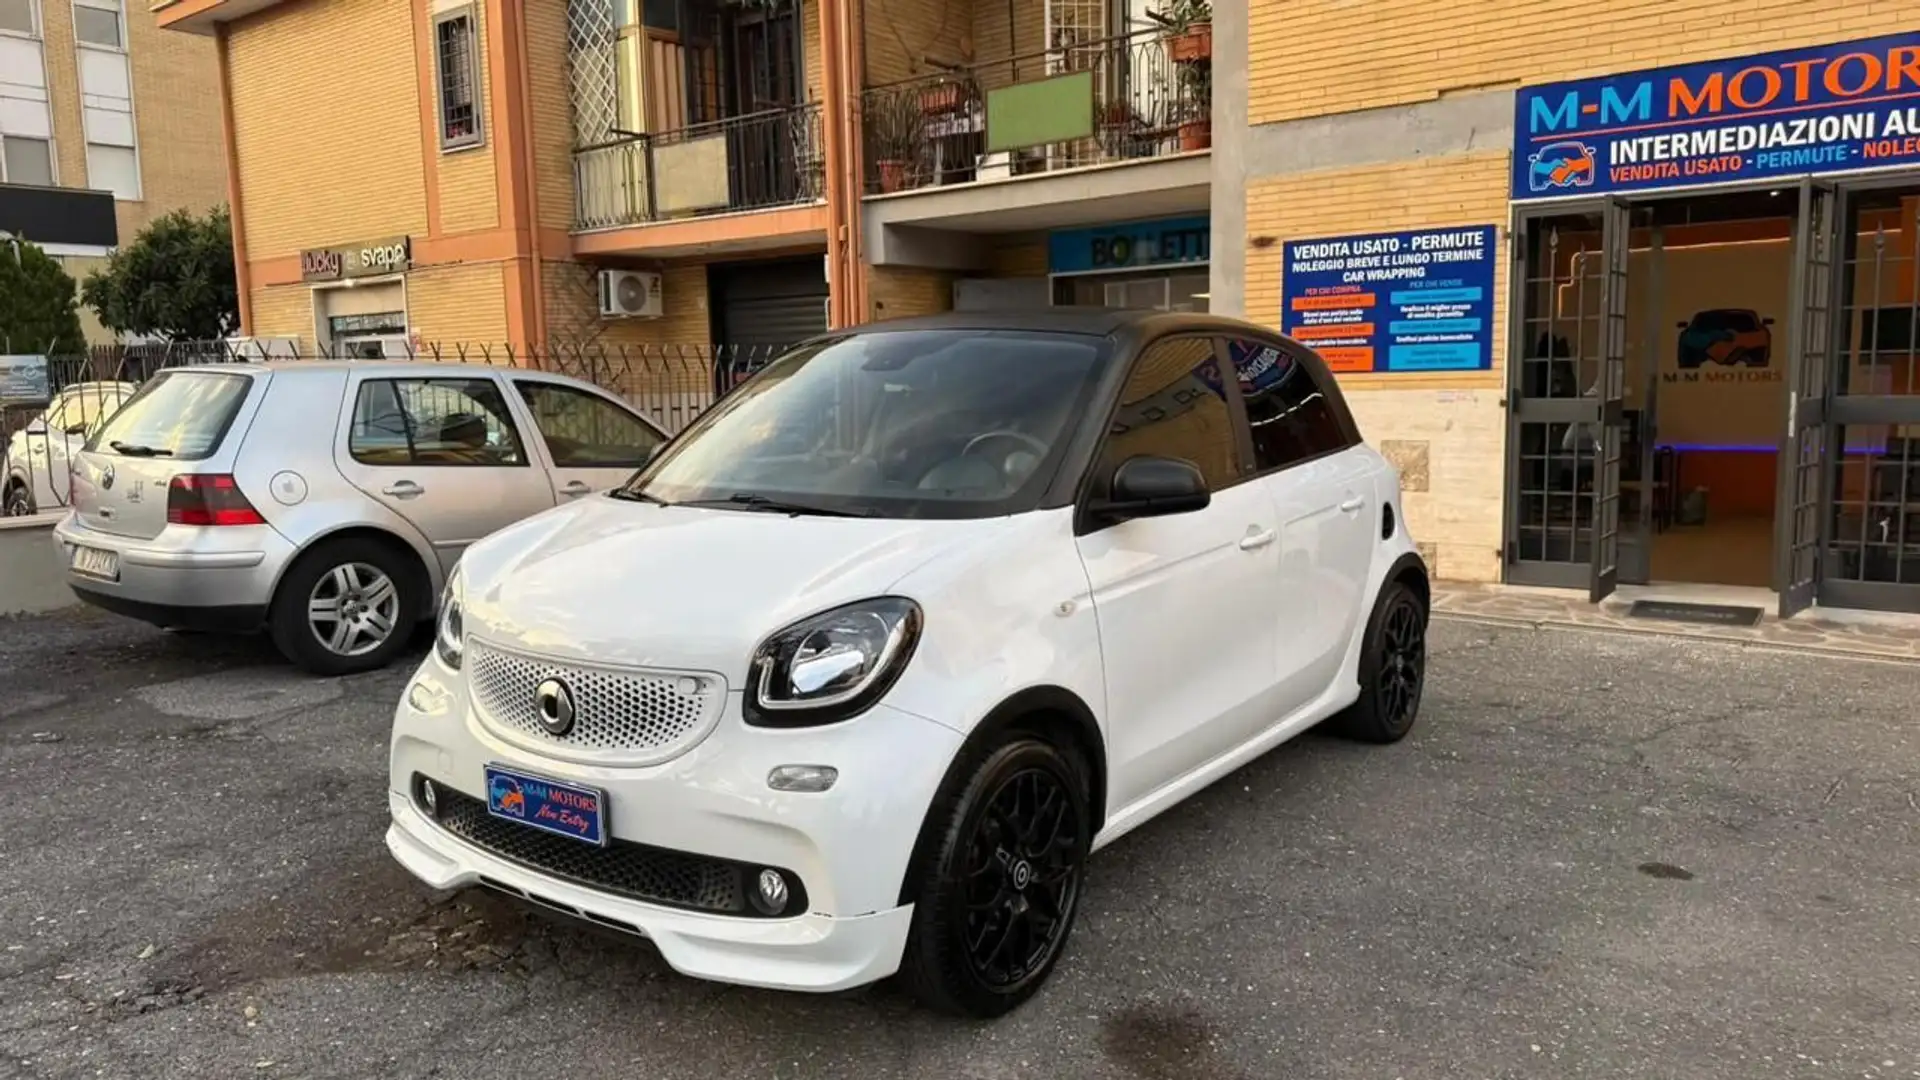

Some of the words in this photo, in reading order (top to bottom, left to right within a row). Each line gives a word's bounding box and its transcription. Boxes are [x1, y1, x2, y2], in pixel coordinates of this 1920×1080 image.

[1530, 81, 1652, 133] M-M
[1668, 45, 1920, 118] MOTOR
[1610, 112, 1875, 165] INTERMEDIAZIONI
[1610, 161, 1680, 183] VENDITA
[1684, 155, 1742, 175] USATO
[1757, 144, 1848, 170] PERMUTE
[1293, 242, 1350, 260] VENDITA
[1353, 238, 1399, 255] USATO
[1411, 231, 1484, 251] PERMUTE
[1292, 258, 1344, 273] NOLEGGIO
[1346, 256, 1381, 269] BREVE
[1383, 255, 1390, 267] E
[1392, 252, 1429, 266] LUNGO
[1432, 248, 1484, 263] TERMINE
[1343, 270, 1366, 283] CAR
[1367, 267, 1425, 281] WRAPPING
[1705, 370, 1783, 382] MOTORS
[548, 788, 597, 812] MOTORS
